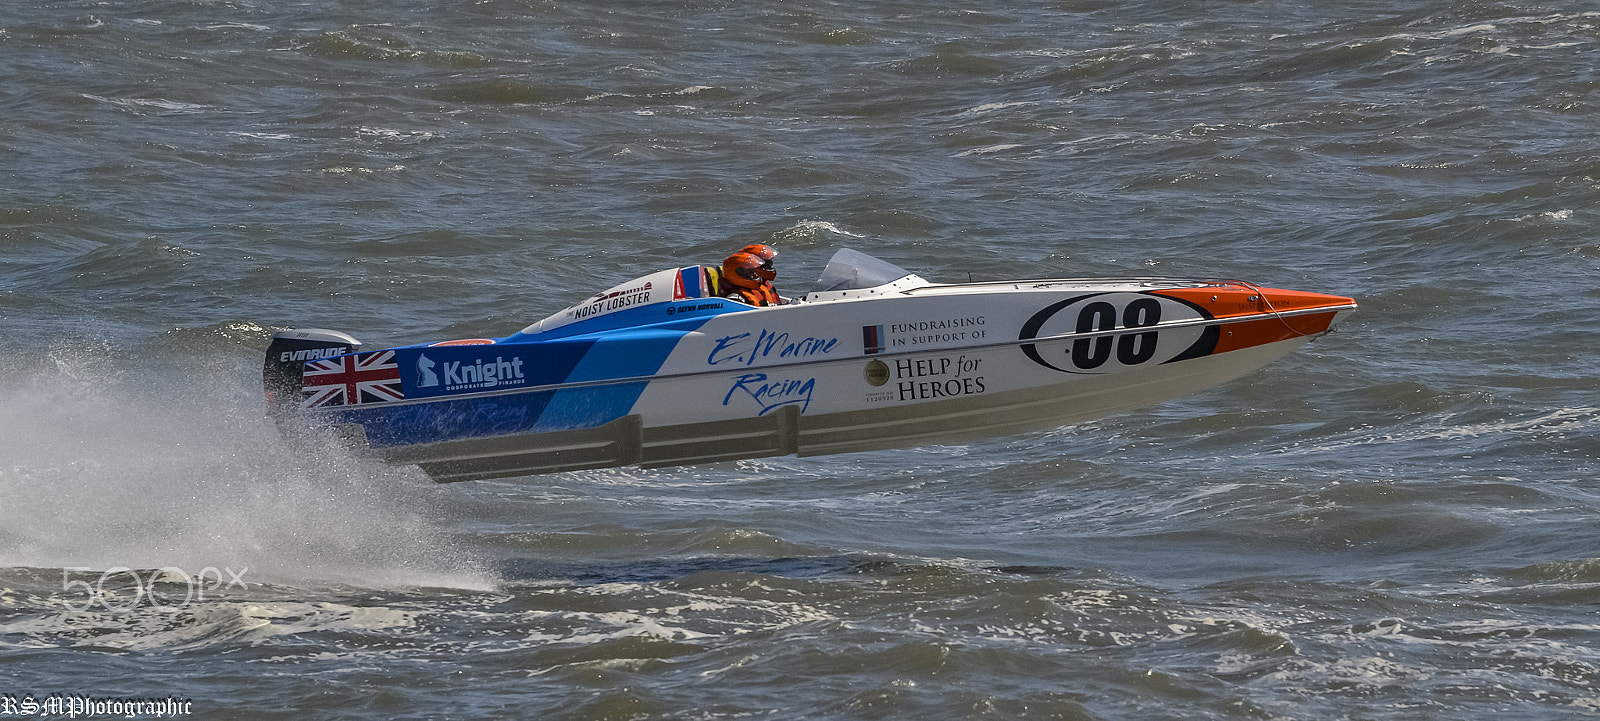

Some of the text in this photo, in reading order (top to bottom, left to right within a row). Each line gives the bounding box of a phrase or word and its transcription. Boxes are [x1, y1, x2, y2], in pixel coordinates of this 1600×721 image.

[574, 302, 604, 320] NOISY
[606, 291, 650, 311] LOBSTER
[891, 316, 985, 333] FUNDRAISING
[1071, 297, 1162, 370] 08
[892, 330, 986, 346] IN SUPPORT OF
[280, 346, 347, 363] EVINRUDE
[895, 358, 951, 379] HELP
[954, 355, 982, 378] for
[443, 356, 524, 388] Knight
[445, 382, 484, 391] CORPORATE
[722, 373, 816, 417] Racing
[897, 376, 986, 402] HEROES
